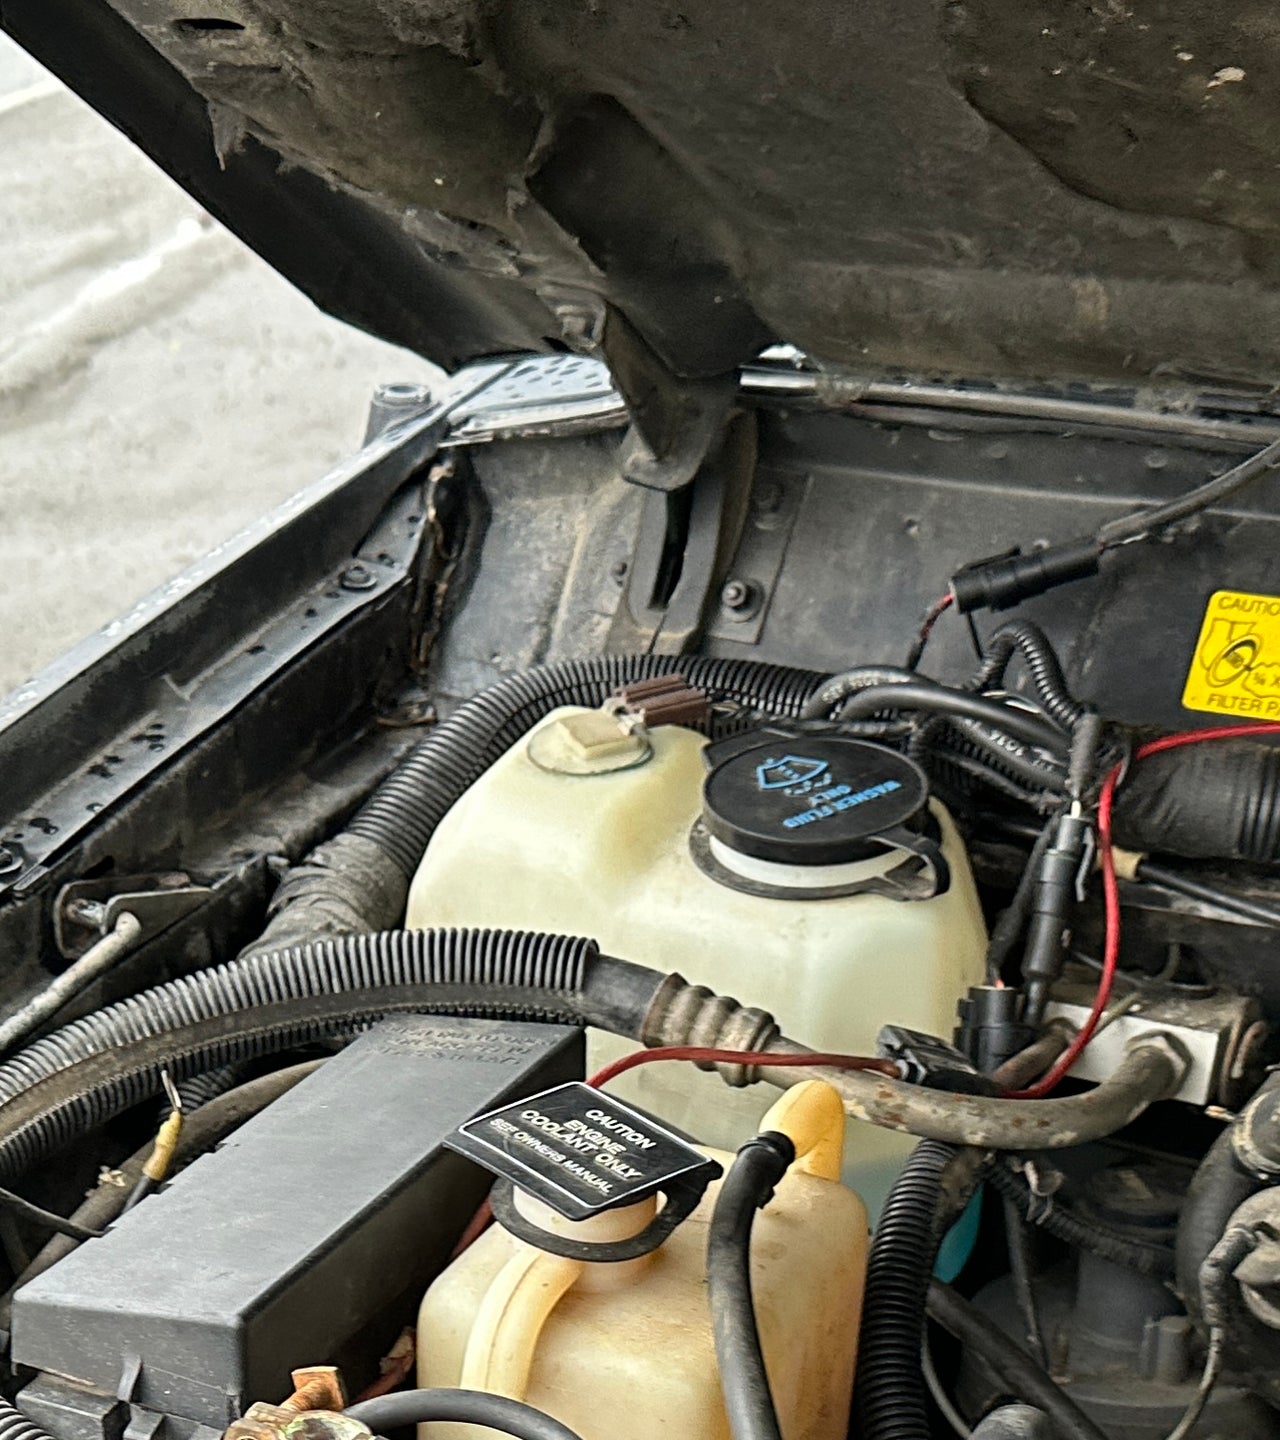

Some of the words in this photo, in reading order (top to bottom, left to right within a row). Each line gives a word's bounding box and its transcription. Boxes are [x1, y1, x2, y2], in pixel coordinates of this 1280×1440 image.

[1206, 693, 1263, 713] FILTER
[520, 1108, 598, 1154] COOLANT
[594, 1151, 644, 1179] ONLY
[563, 1118, 628, 1155] ENGINE
[584, 1108, 657, 1151] CAUTION
[513, 1130, 568, 1164] OWNERS
[562, 1160, 614, 1194] MANUAL
